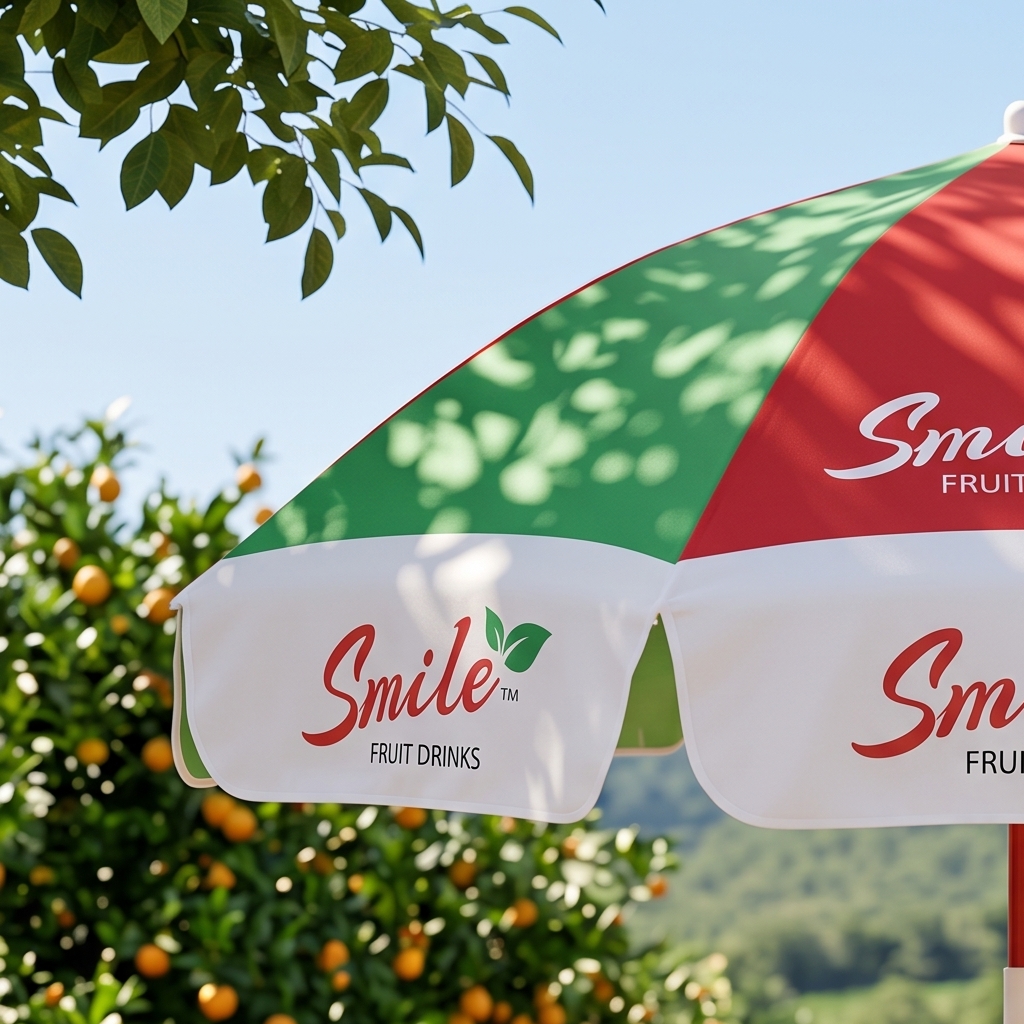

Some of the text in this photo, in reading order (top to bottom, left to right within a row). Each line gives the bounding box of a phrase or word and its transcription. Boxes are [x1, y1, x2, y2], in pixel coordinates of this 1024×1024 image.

[301, 616, 500, 747] Smile
[370, 742, 480, 770] FRUIT DRINKS
